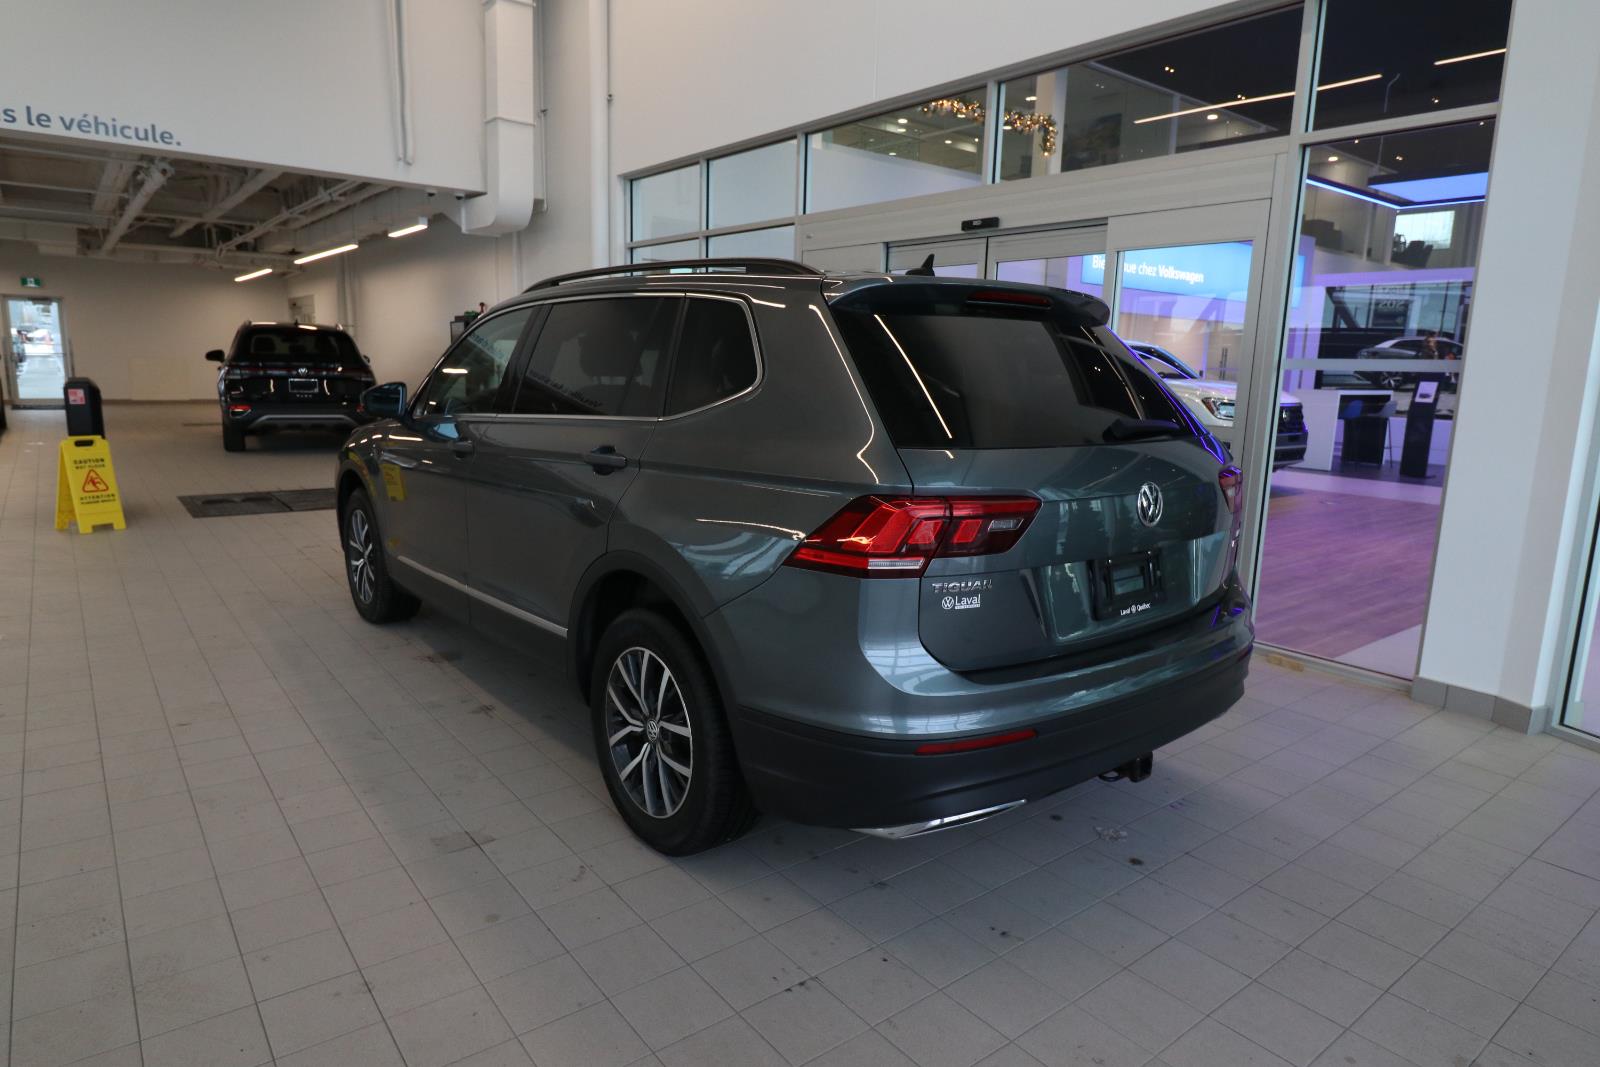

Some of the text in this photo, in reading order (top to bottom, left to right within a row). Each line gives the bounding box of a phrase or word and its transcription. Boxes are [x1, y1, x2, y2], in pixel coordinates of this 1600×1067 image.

[0, 105, 182, 146] s le véhicule.
[1138, 262, 1157, 277] chez
[1158, 264, 1204, 284] Volkswagen
[932, 579, 992, 592] TIGUAN
[955, 593, 981, 606] Laval
